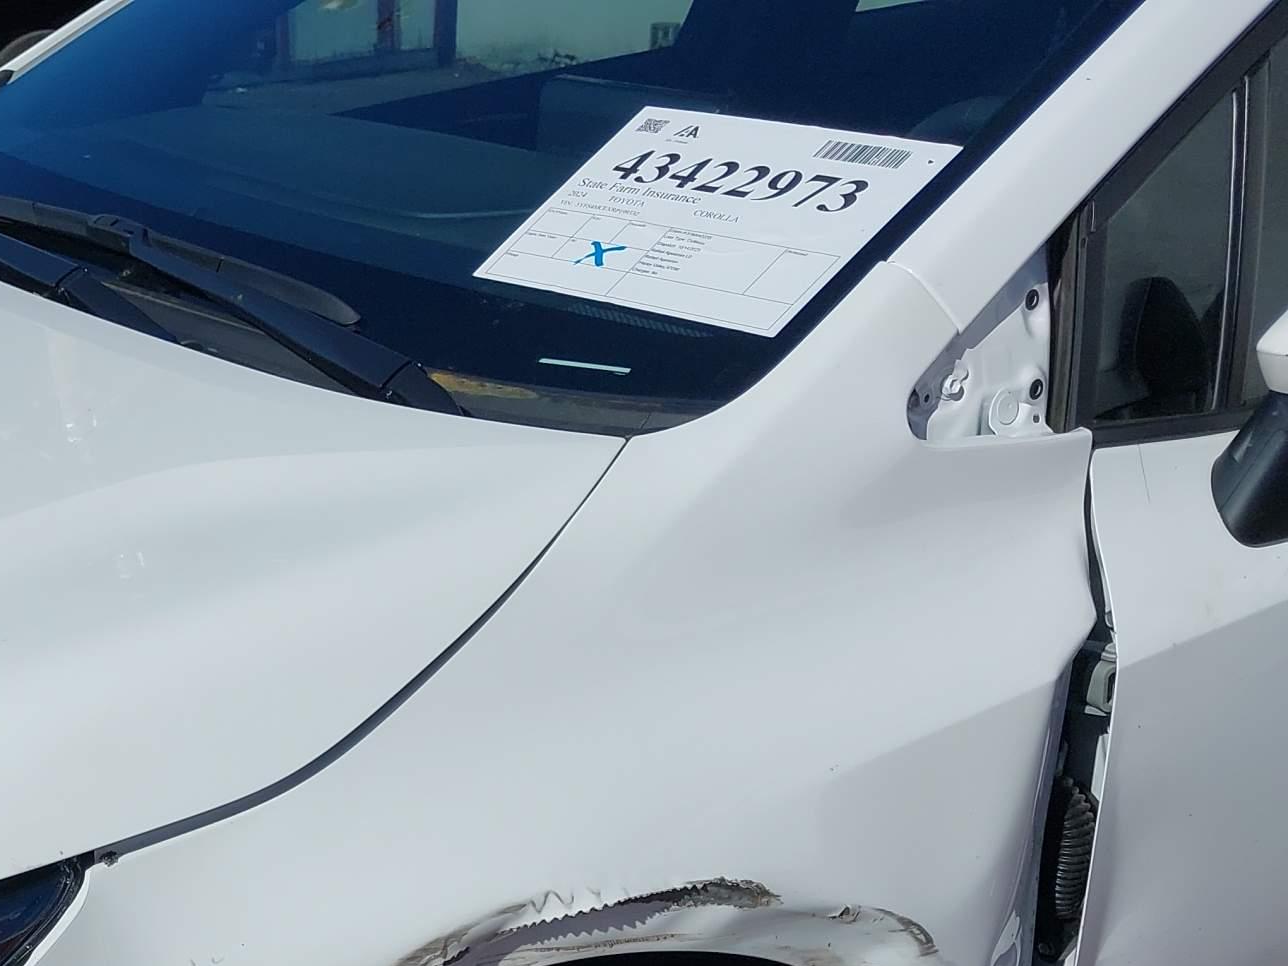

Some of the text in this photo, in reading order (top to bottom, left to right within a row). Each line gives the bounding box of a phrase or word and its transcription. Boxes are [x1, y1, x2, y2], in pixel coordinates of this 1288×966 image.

[578, 177, 702, 204] State Farm Insurance
[612, 149, 869, 213] 43422973
[609, 196, 645, 208] TOYOTA
[693, 209, 740, 224] COROLLA
